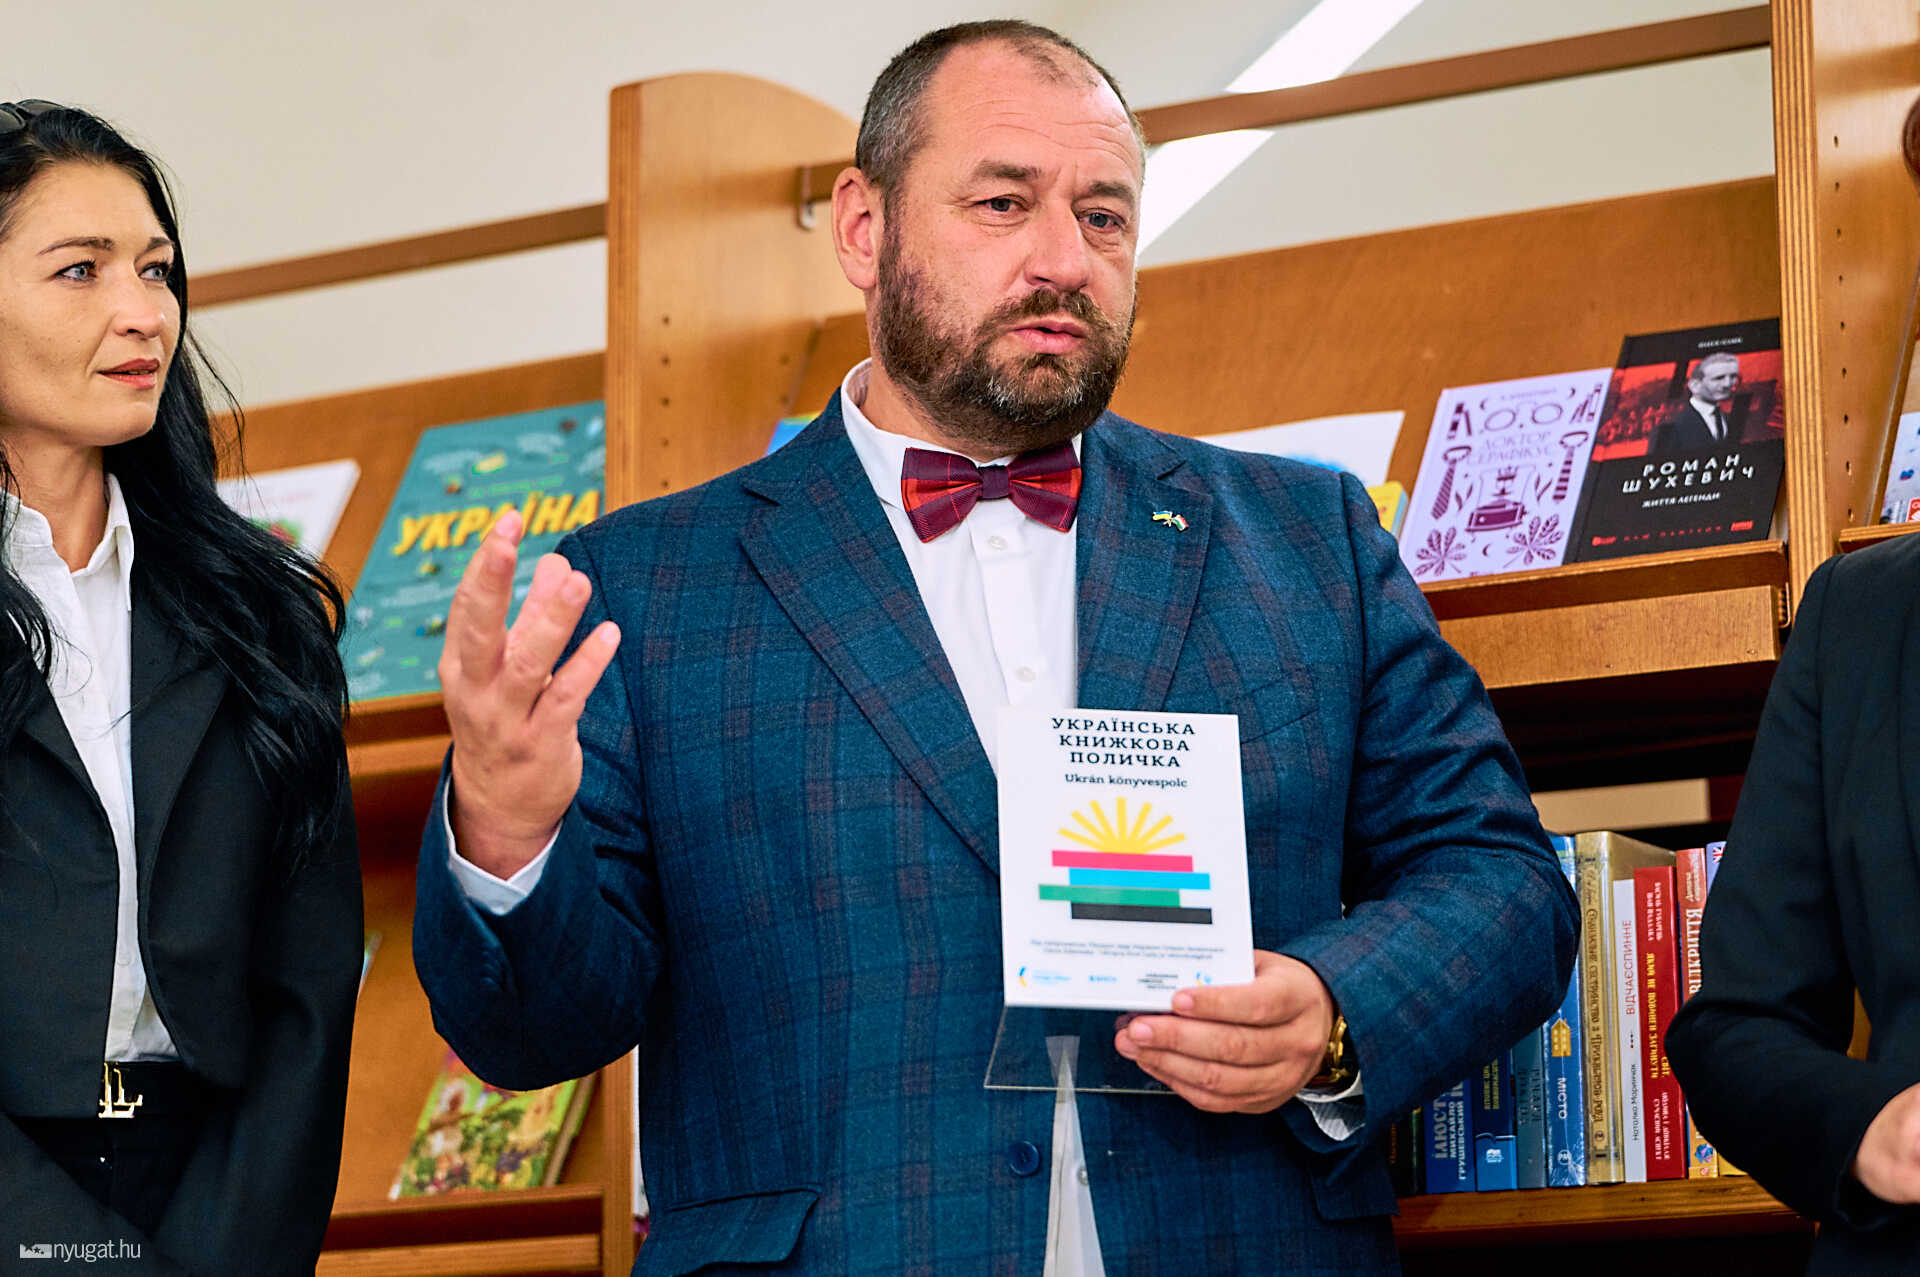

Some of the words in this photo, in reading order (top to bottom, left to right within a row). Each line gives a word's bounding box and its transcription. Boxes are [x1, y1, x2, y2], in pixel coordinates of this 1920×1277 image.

[1643, 453, 1741, 477] РОМАН
[1622, 465, 1754, 493] ШУХЕВИЧ
[1642, 497, 1676, 508] ЖИТТЯ
[1678, 492, 1720, 505] ЛЕГЕНДИ
[1051, 717, 1196, 735] УКРАЇНСЬКА
[1059, 735, 1191, 752] КНИЖКОВА
[1070, 752, 1181, 768] ПОЛИЧКА
[1065, 773, 1105, 785] Ukrán
[1108, 775, 1188, 790] könyvespolc
[1622, 920, 1635, 1015] ВІДЧАЄСПИННЕ
[1558, 1077, 1567, 1120] МІСТО
[1432, 1097, 1448, 1159] ІЛЮСТ
[1448, 1101, 1457, 1158] МИХАЙЛО
[1456, 1101, 1466, 1180] ГРУШЕВСЬКИЙ
